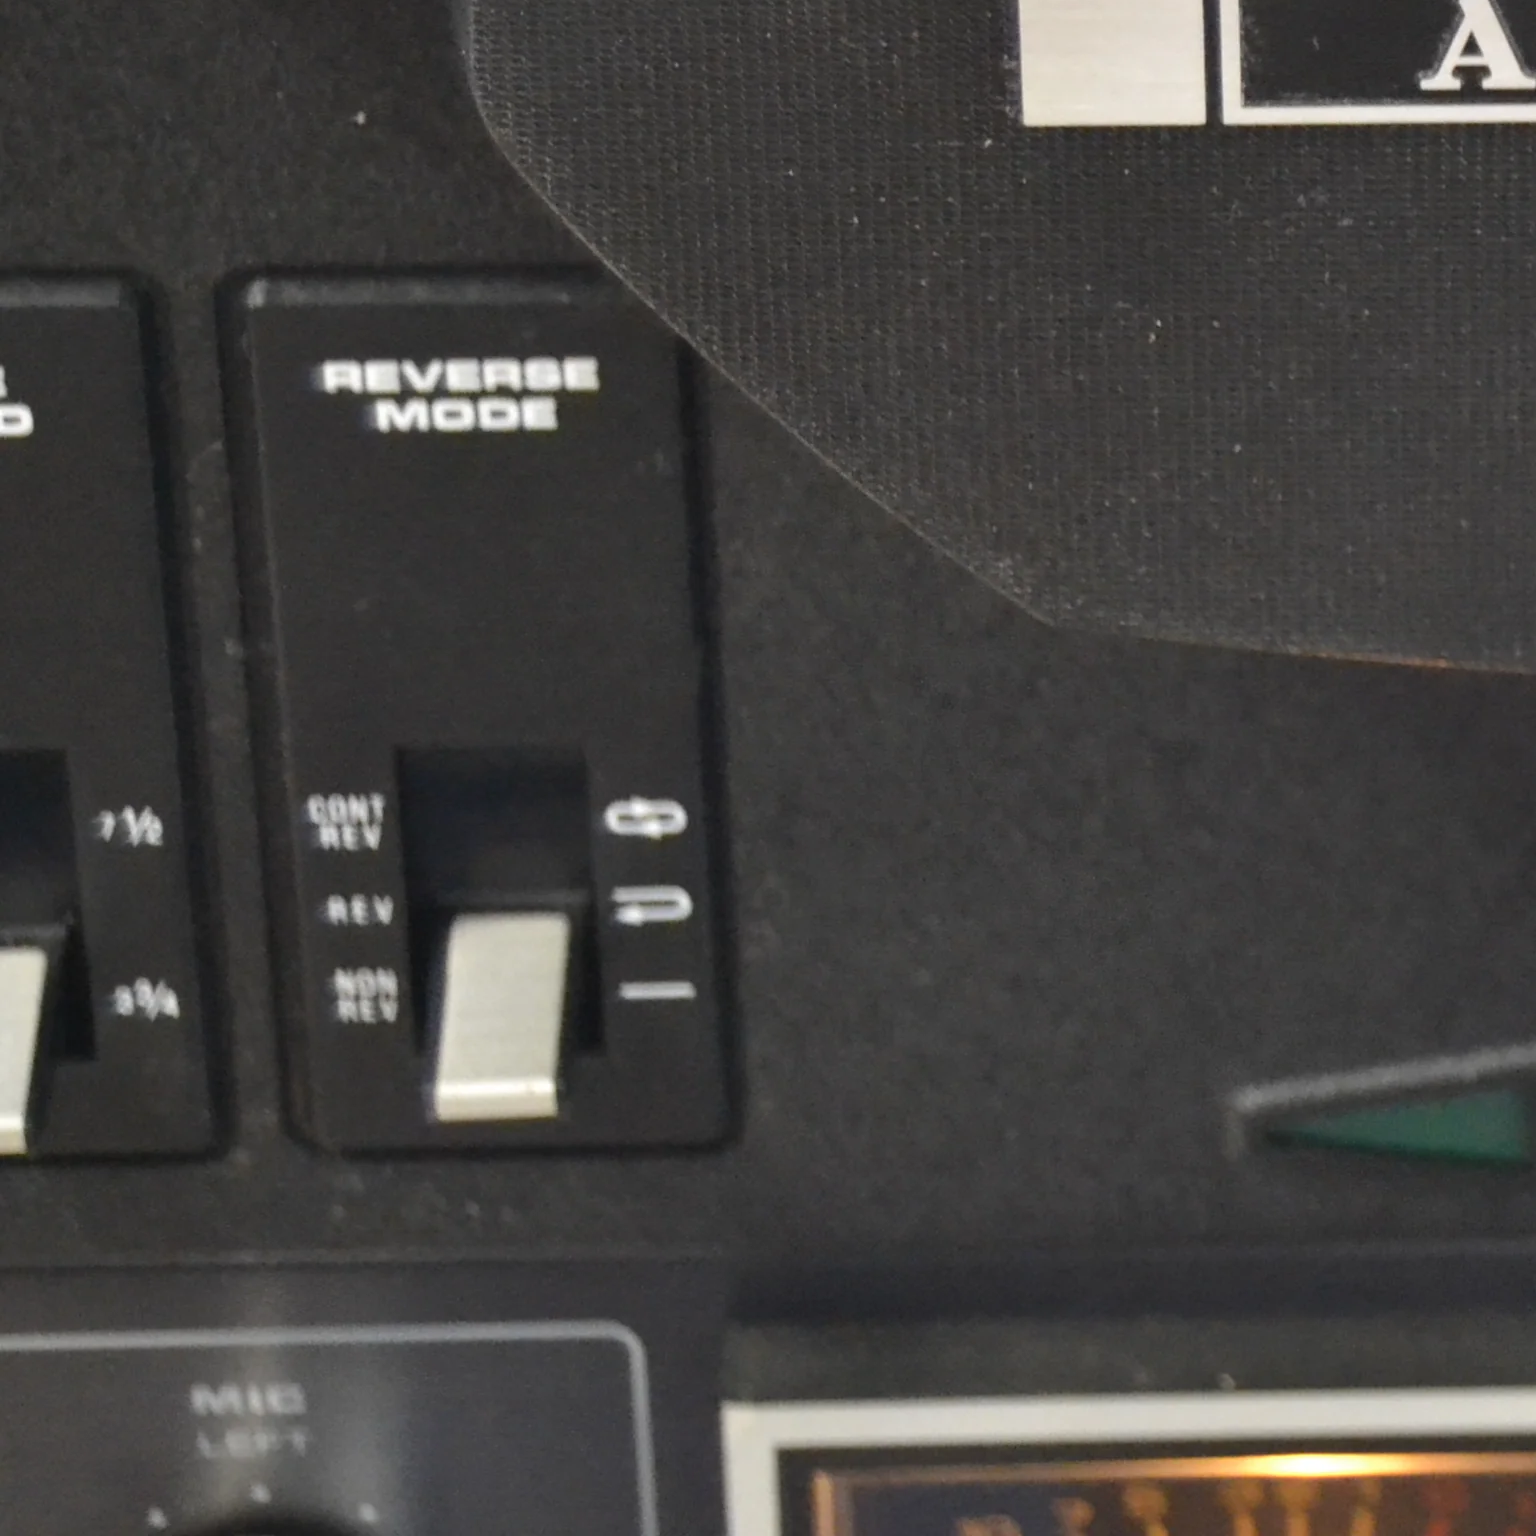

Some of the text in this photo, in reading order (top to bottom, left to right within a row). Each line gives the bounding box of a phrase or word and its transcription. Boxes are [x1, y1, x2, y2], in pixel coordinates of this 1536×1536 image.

[320, 357, 600, 394] REVERSE
[373, 396, 558, 432] MODE
[306, 793, 385, 824] CONT
[317, 824, 382, 851] REV
[326, 894, 395, 926] REV
[337, 996, 398, 1023] REV
